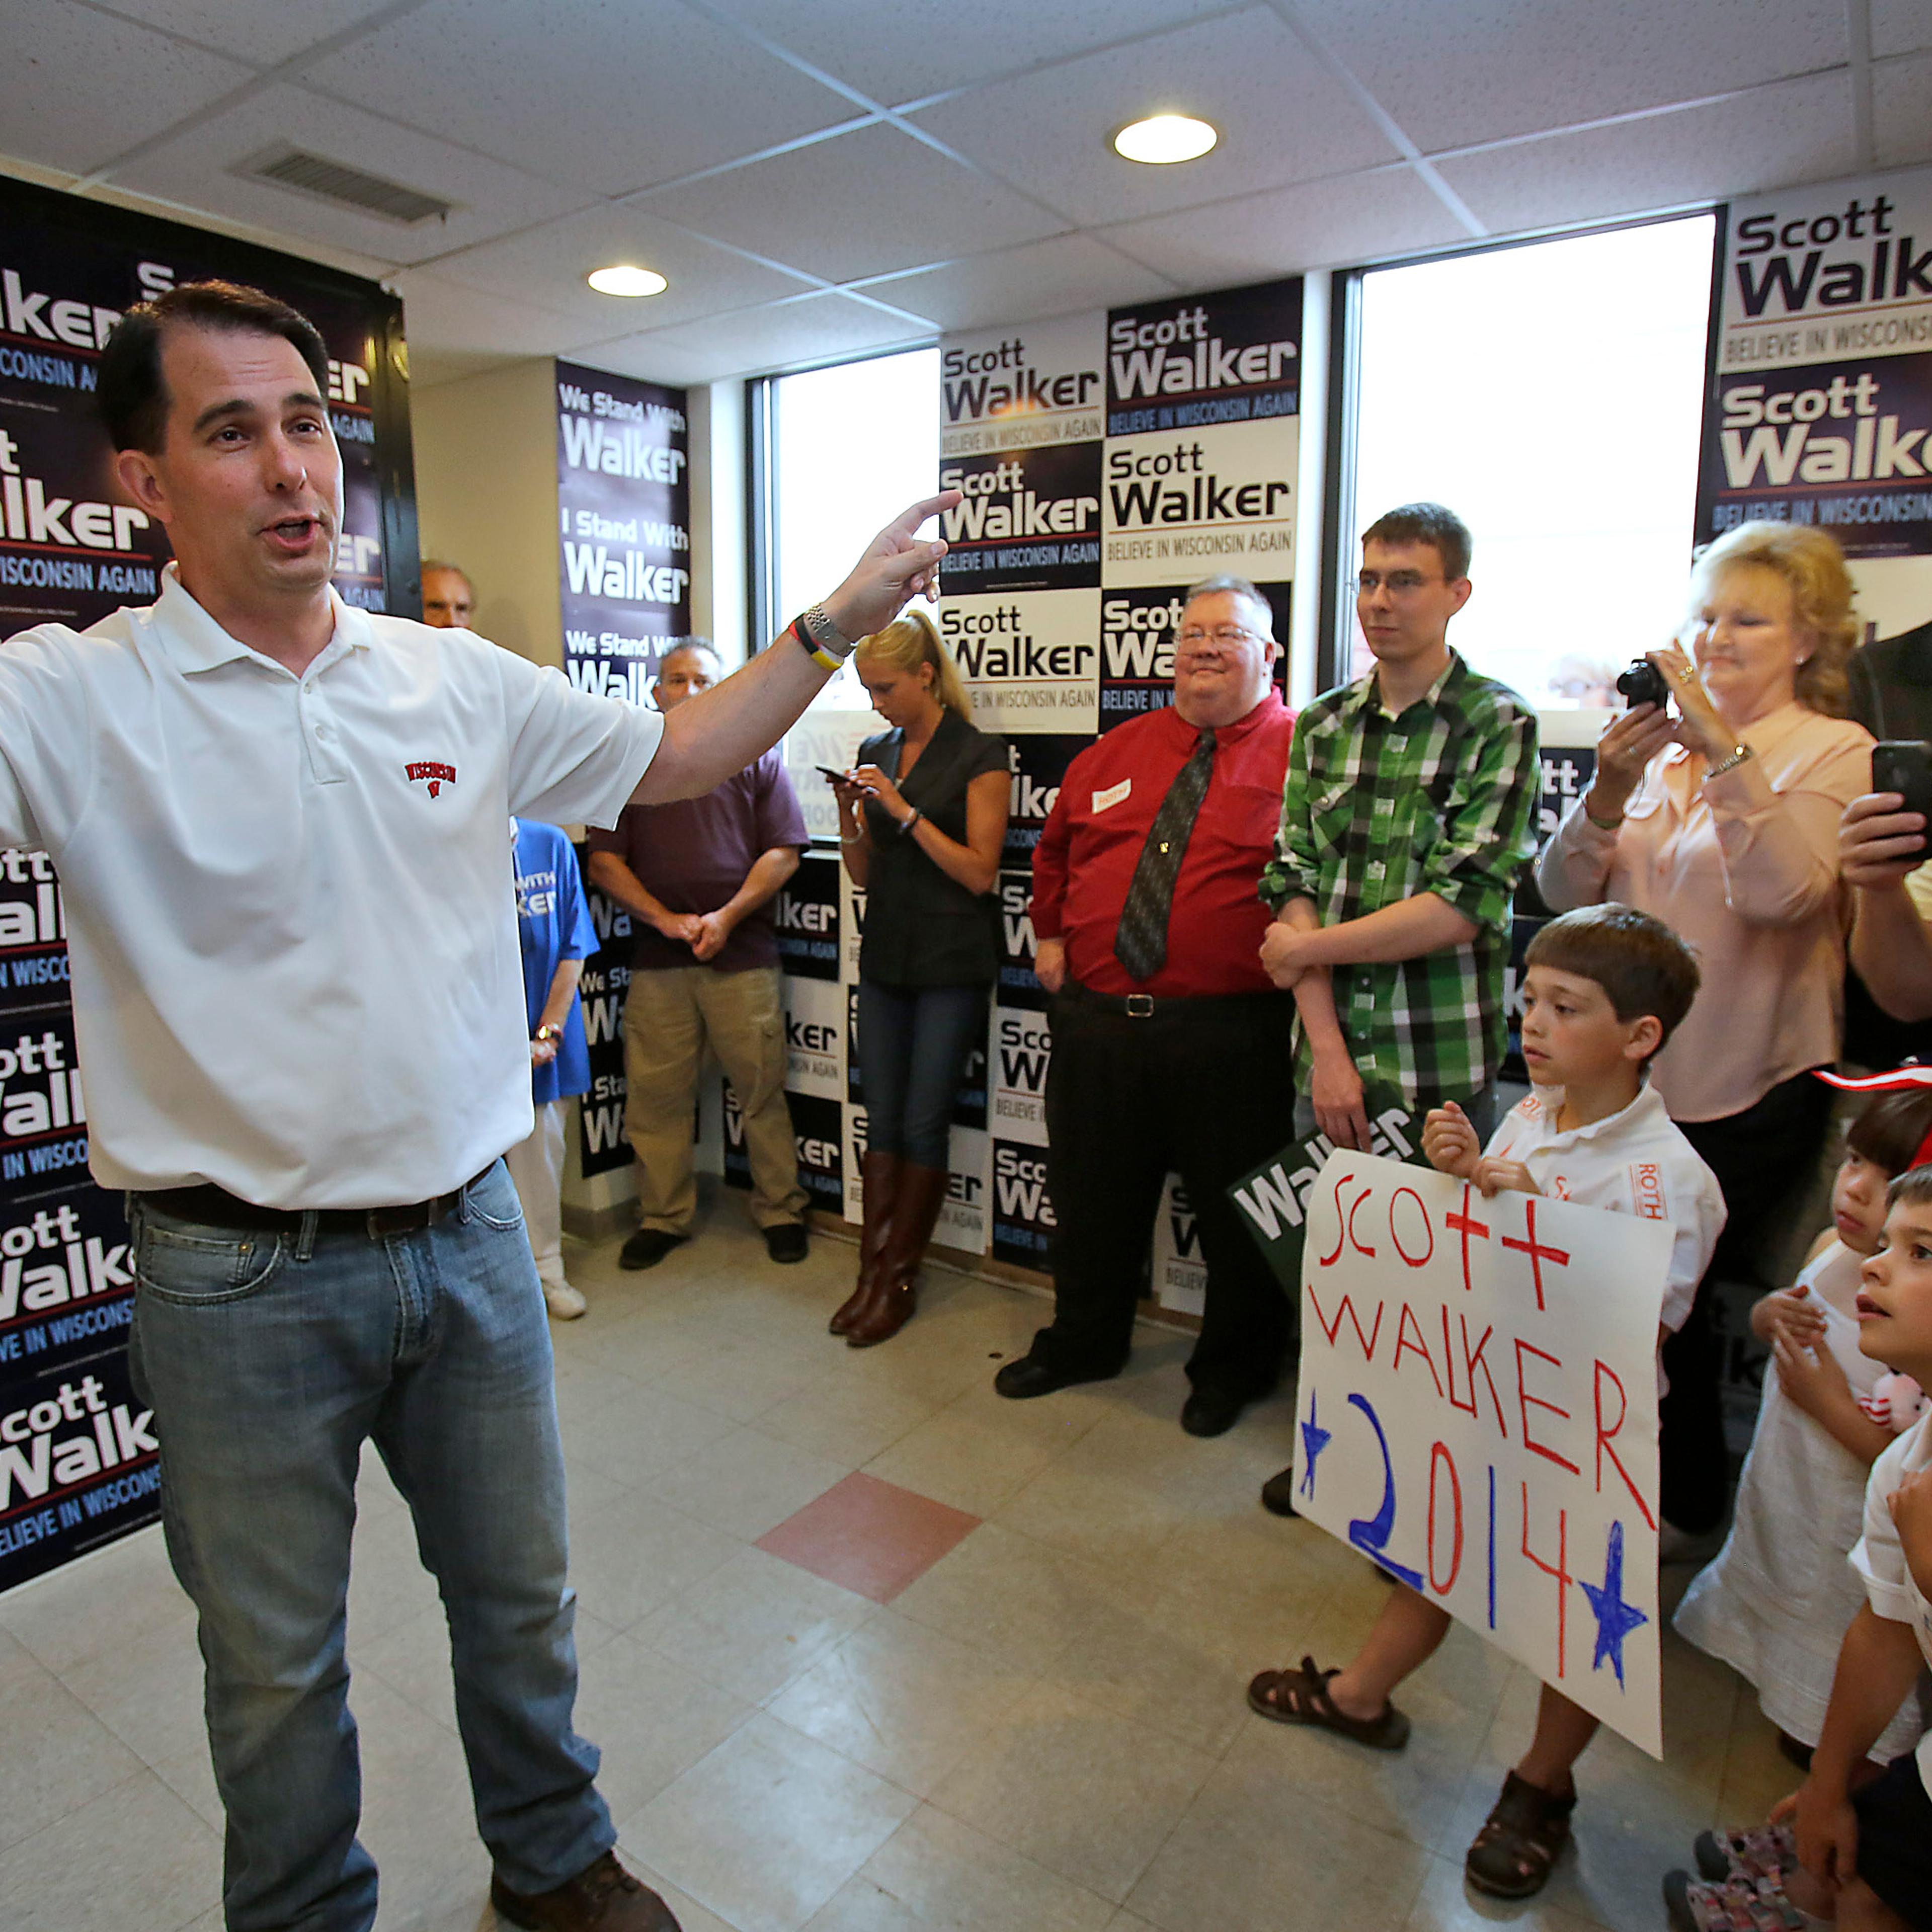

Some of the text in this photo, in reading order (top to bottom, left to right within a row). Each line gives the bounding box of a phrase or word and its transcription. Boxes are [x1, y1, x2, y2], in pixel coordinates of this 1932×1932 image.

[1737, 195, 1894, 256] Scott
[1737, 237, 1932, 317] Walk
[0, 268, 123, 351] ker
[1110, 306, 1208, 353] Scott
[0, 348, 75, 388] CONSIN
[944, 338, 1024, 377] Scott
[1111, 338, 1298, 401] Walker
[558, 382, 591, 413] We
[592, 391, 644, 423] Stand
[943, 367, 1099, 422] Walker
[1176, 396, 1250, 427] WISCONSIN
[1253, 390, 1298, 417] AGAIN
[1721, 373, 1881, 429] Scott
[560, 413, 687, 486] Walker
[1110, 442, 1204, 479] Scott
[1720, 415, 1932, 490] Walk
[940, 461, 1024, 497] Scott
[1109, 474, 1290, 527] Walker
[0, 474, 150, 551] lker
[561, 507, 689, 551] I Stand With
[942, 490, 1099, 543] Walker
[998, 545, 1060, 569] WISCONSIN
[1061, 541, 1100, 565] AGAIN
[1108, 529, 1292, 561] BELIEVE IN WISCONSIN AGAIN
[0, 555, 156, 597] ISCONSIN AGAIN
[564, 541, 689, 604] Walker
[942, 606, 1021, 635] Scott
[1104, 597, 1184, 631] Scot
[565, 630, 597, 655] We
[600, 632, 650, 658] Stand
[944, 636, 1094, 678] Walker
[567, 659, 660, 710] Walk
[996, 689, 1057, 707] WISCONSIN
[1061, 688, 1096, 707] AGAIN
[1102, 689, 1166, 710] BELIEVE IN
[775, 891, 837, 932] lker
[785, 1011, 837, 1051] ker
[1001, 1020, 1053, 1051] Sco
[0, 1031, 65, 1079] ott
[28, 1138, 89, 1175] WISCO
[1, 1204, 82, 1258] ott
[48, 1298, 135, 1346] WISCONS
[0, 1375, 108, 1443] cott
[1308, 1284, 1658, 1532] WALKER
[0, 1404, 159, 1511] Walk
[59, 1498, 83, 1530] IN
[1347, 1394, 1573, 1678] 2014
